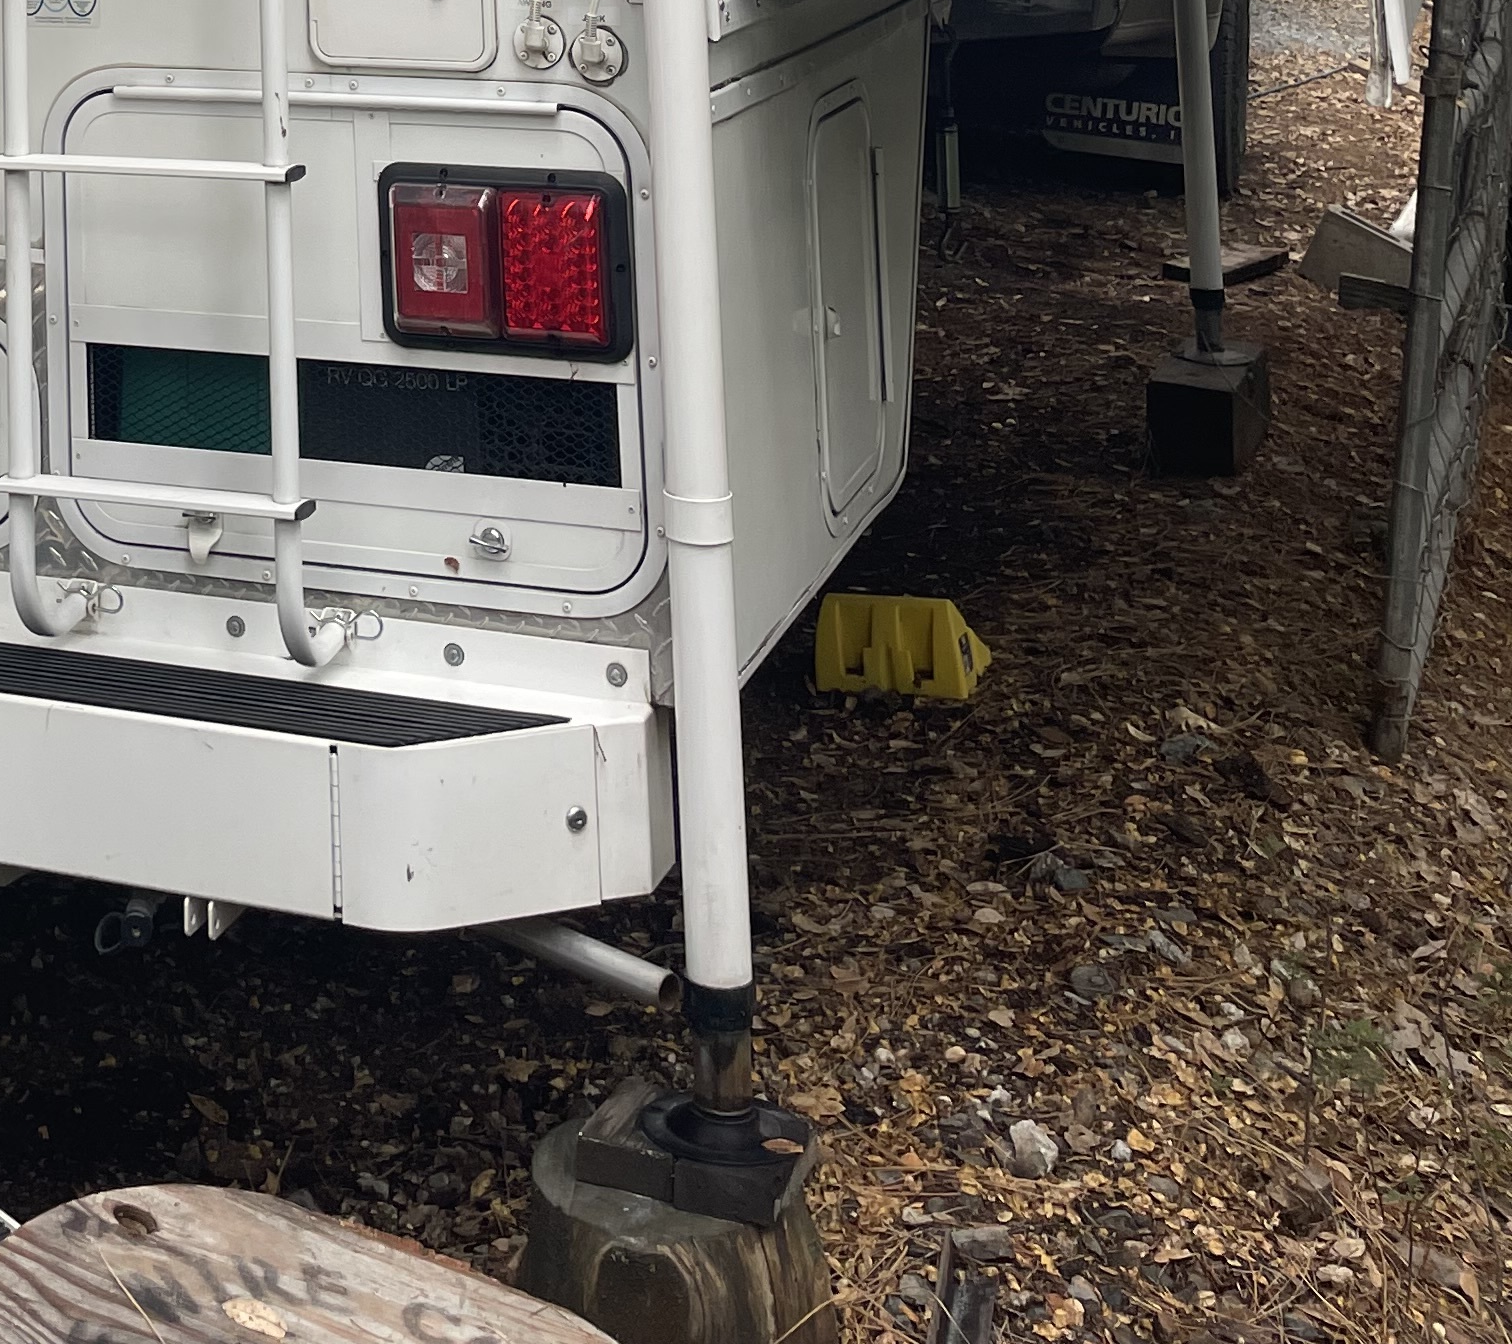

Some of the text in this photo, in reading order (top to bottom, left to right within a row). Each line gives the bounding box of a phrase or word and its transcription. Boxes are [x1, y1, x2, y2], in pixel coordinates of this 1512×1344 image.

[1046, 93, 1183, 128] CENTURIO
[1046, 115, 1157, 139] VEHICLES,
[394, 371, 438, 390] 2500
